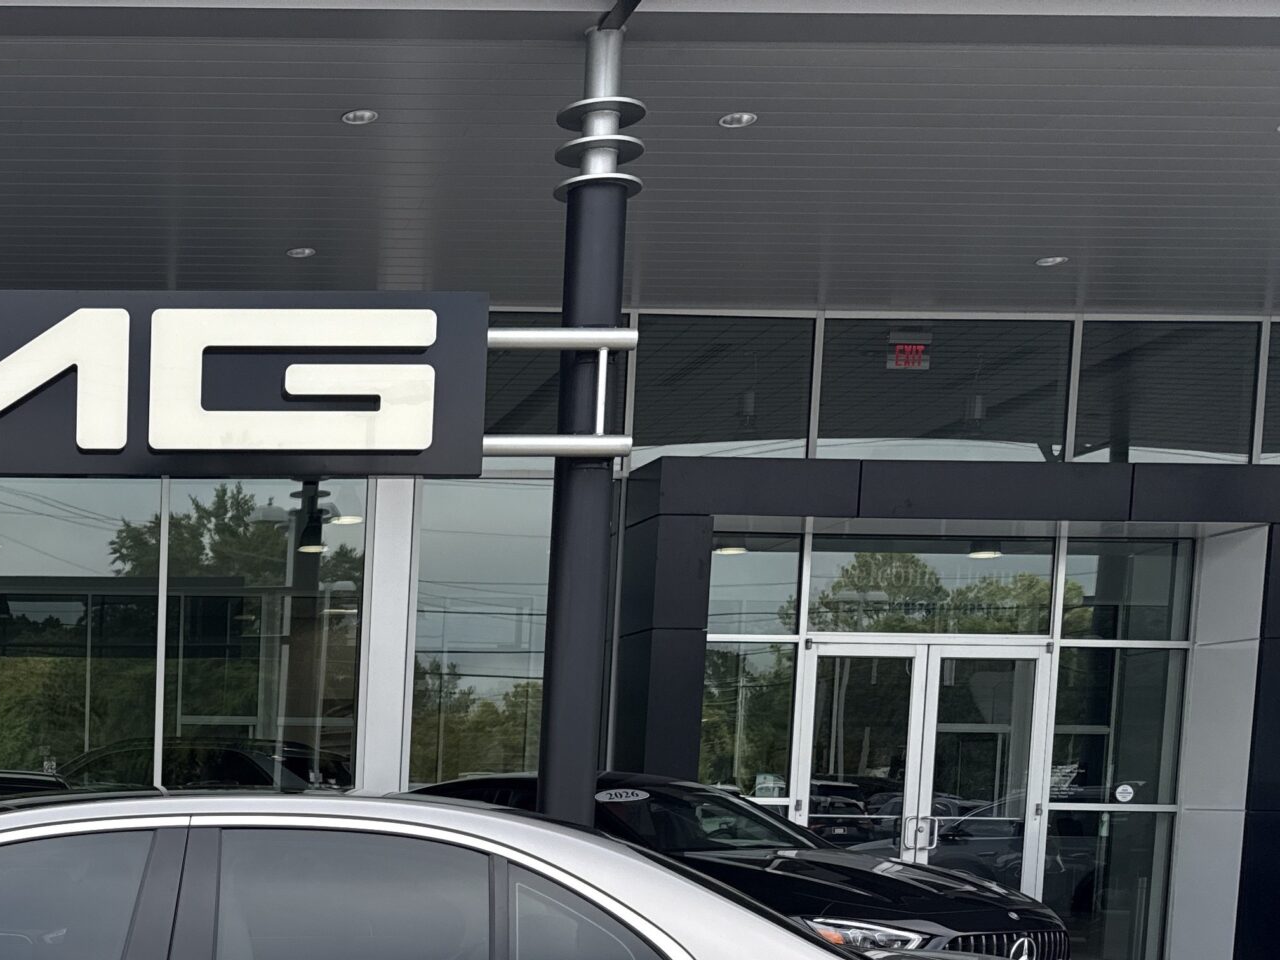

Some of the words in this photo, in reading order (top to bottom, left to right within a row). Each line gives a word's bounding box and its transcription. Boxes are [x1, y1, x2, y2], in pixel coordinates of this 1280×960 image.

[895, 345, 926, 367] EXIT
[833, 564, 943, 587] elcome
[606, 791, 639, 800] 2026
